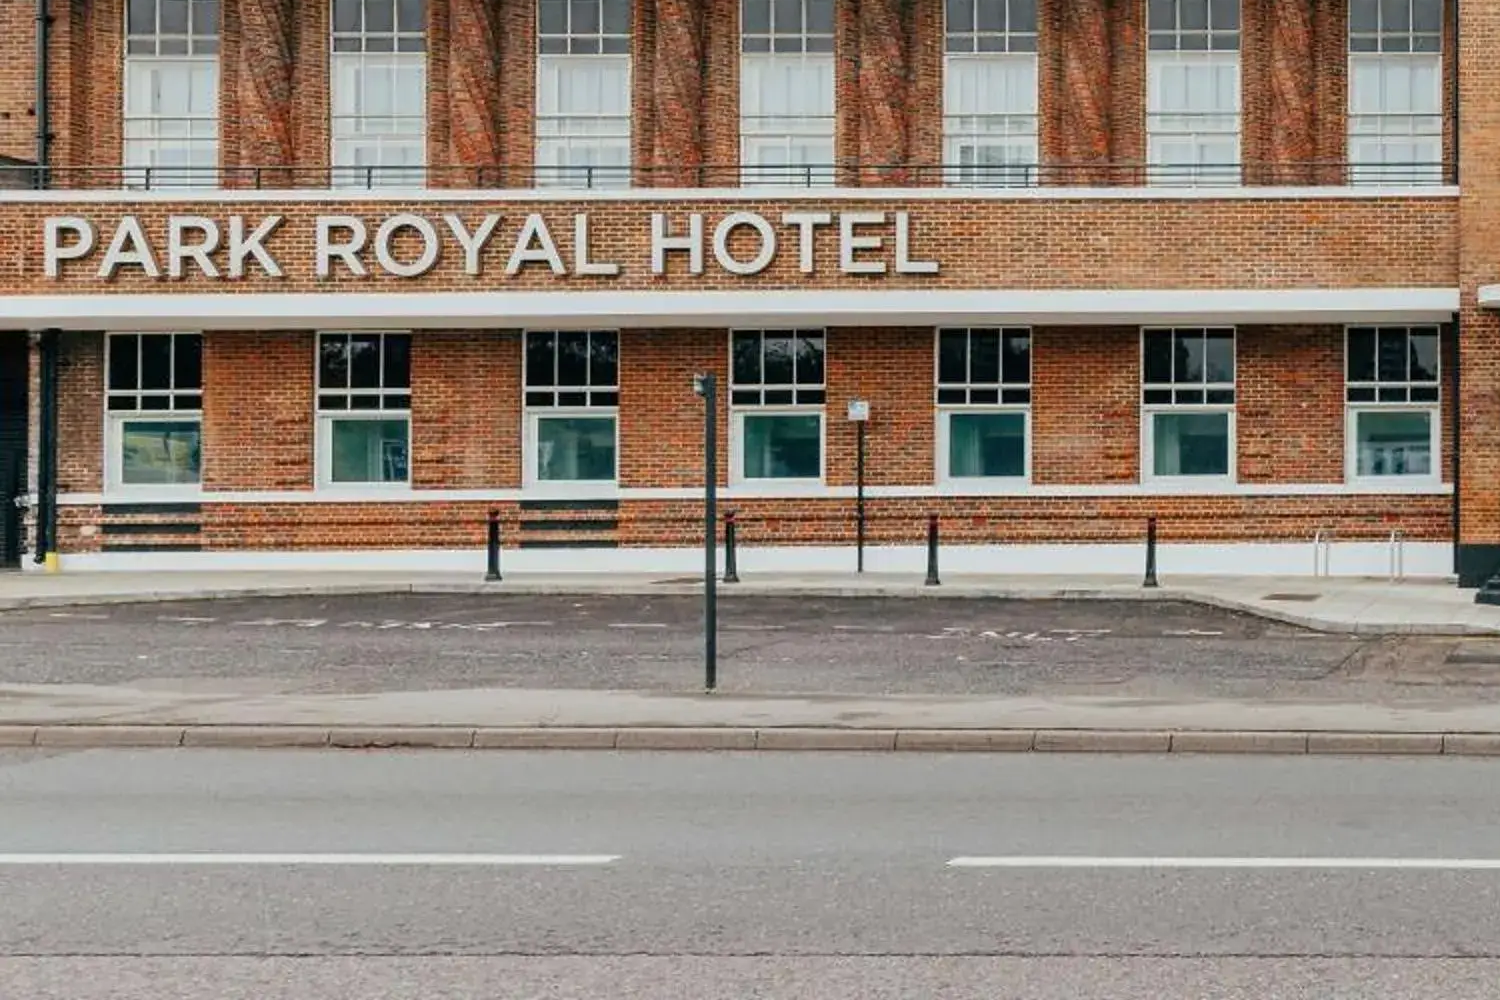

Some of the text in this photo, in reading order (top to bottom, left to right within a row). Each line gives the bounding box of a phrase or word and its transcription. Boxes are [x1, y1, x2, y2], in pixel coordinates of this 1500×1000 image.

[43, 211, 940, 279] PARK ROYAL HOTEL
